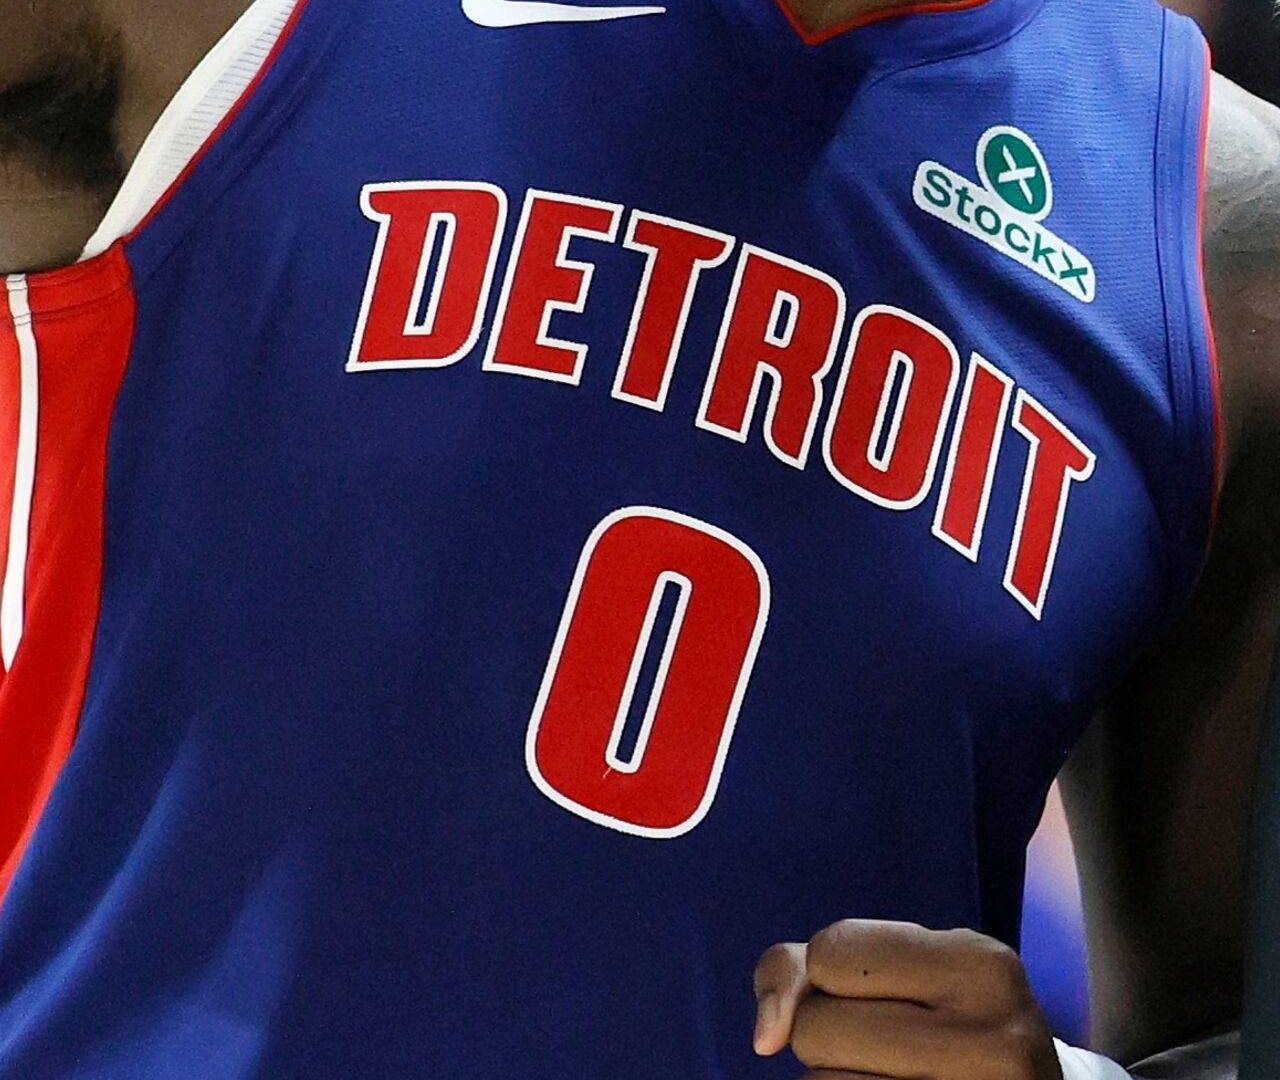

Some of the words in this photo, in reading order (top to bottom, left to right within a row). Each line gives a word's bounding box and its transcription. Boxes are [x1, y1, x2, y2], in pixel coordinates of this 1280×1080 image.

[922, 169, 1089, 297] StockX
[345, 179, 1097, 622] DETROIT
[524, 505, 772, 839] 0
